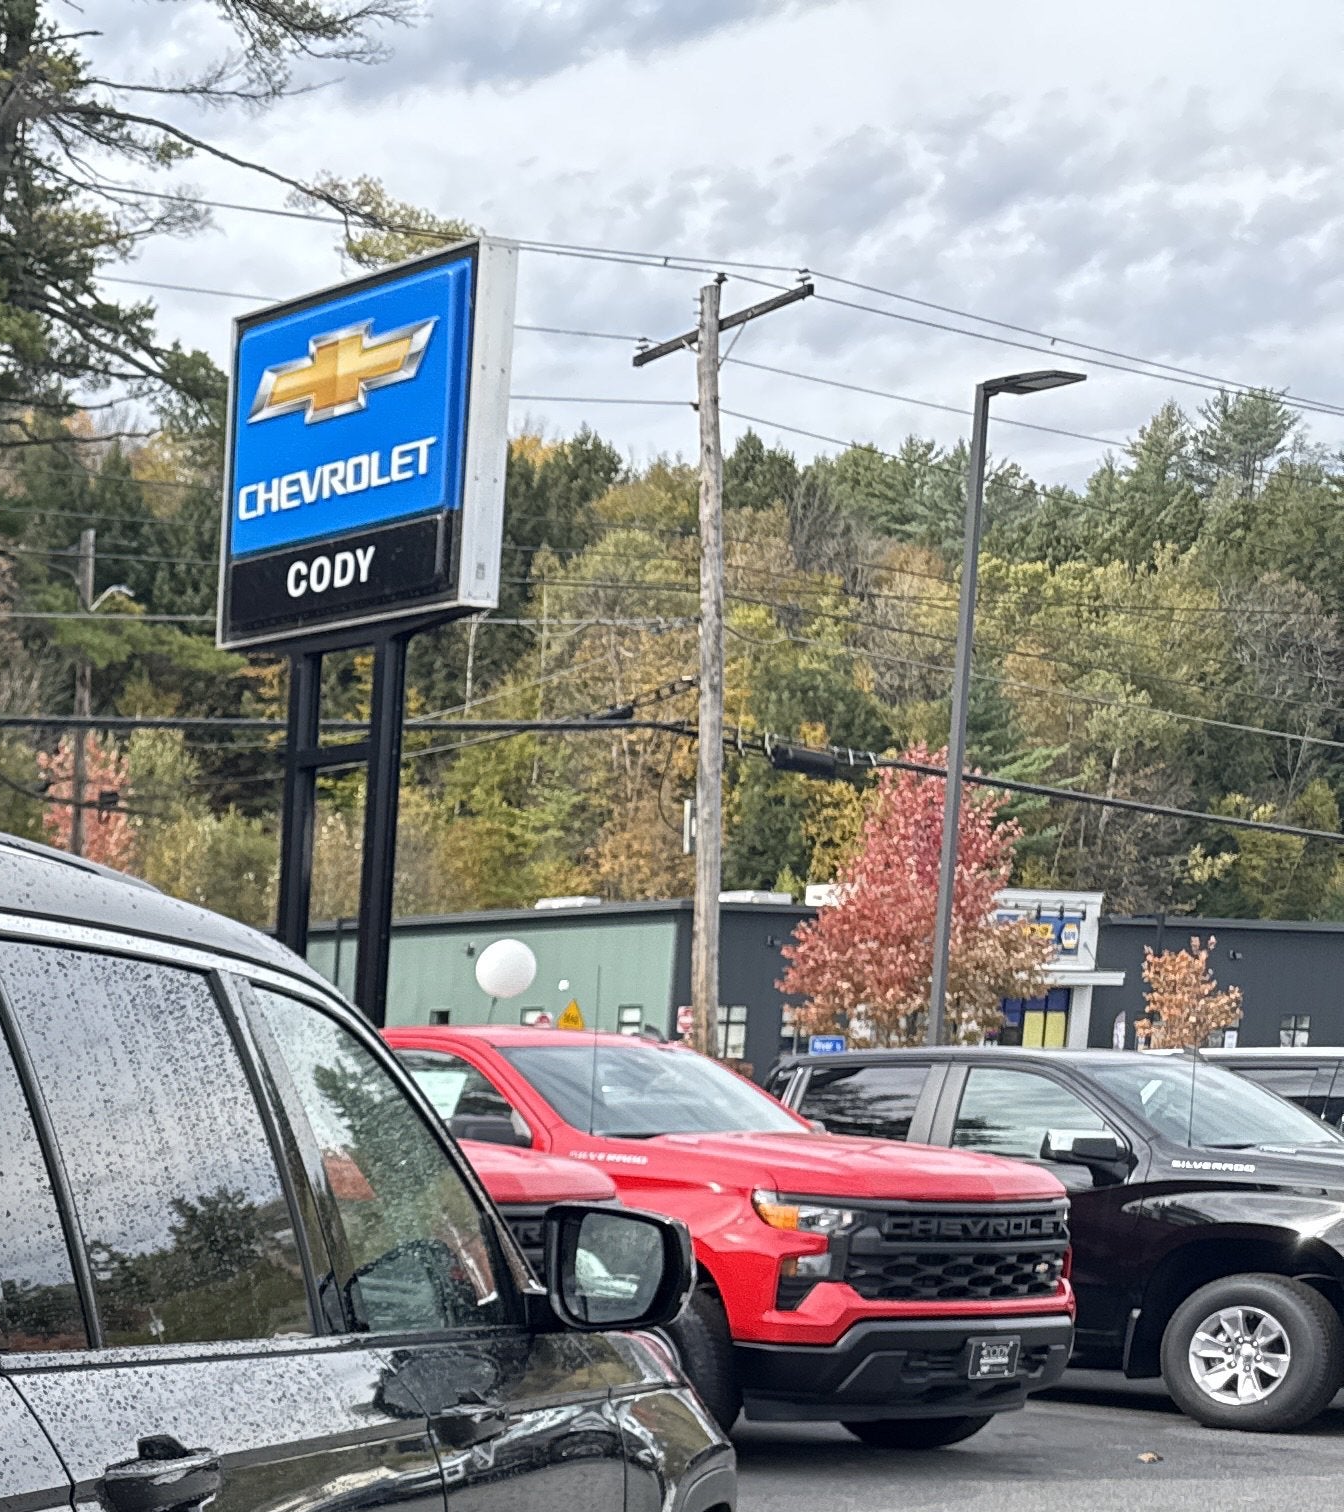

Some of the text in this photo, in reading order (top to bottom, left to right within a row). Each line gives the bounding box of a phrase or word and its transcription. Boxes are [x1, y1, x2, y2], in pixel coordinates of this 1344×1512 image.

[238, 436, 437, 520] CHEVROLET
[286, 545, 376, 597] CODY
[1171, 1160, 1255, 1173] SILVERADO
[883, 1216, 1064, 1238] CHEVROLET
